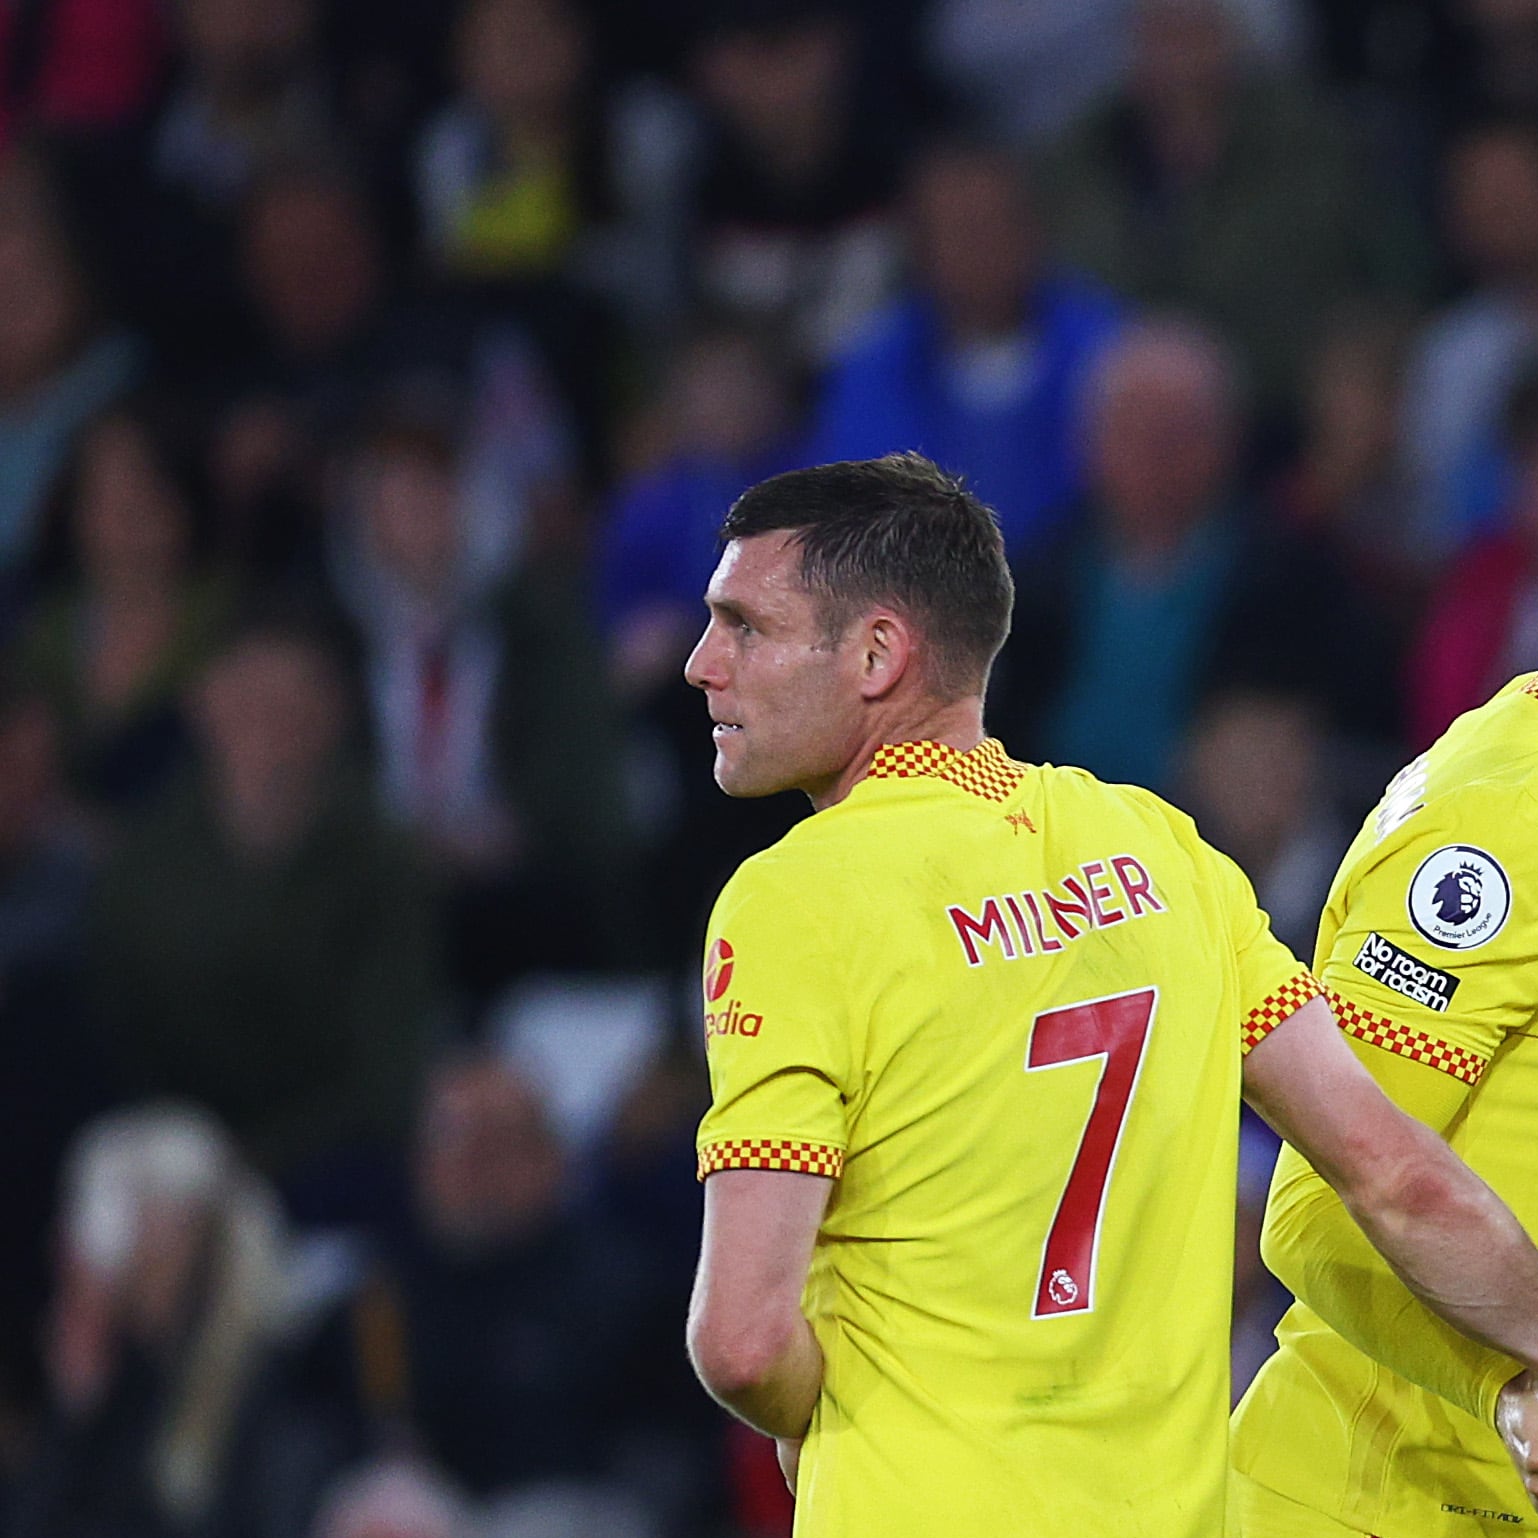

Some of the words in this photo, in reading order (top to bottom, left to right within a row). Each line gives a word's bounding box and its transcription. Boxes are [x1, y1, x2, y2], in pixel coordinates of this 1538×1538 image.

[947, 854, 1165, 966] MILNER
[1433, 925, 1465, 939] Premier
[1466, 912, 1492, 937] League
[1353, 951, 1384, 976] for
[1381, 971, 1448, 1013] racism
[1363, 932, 1393, 962] No
[1391, 954, 1448, 993] room
[1024, 985, 1159, 1320] 7
